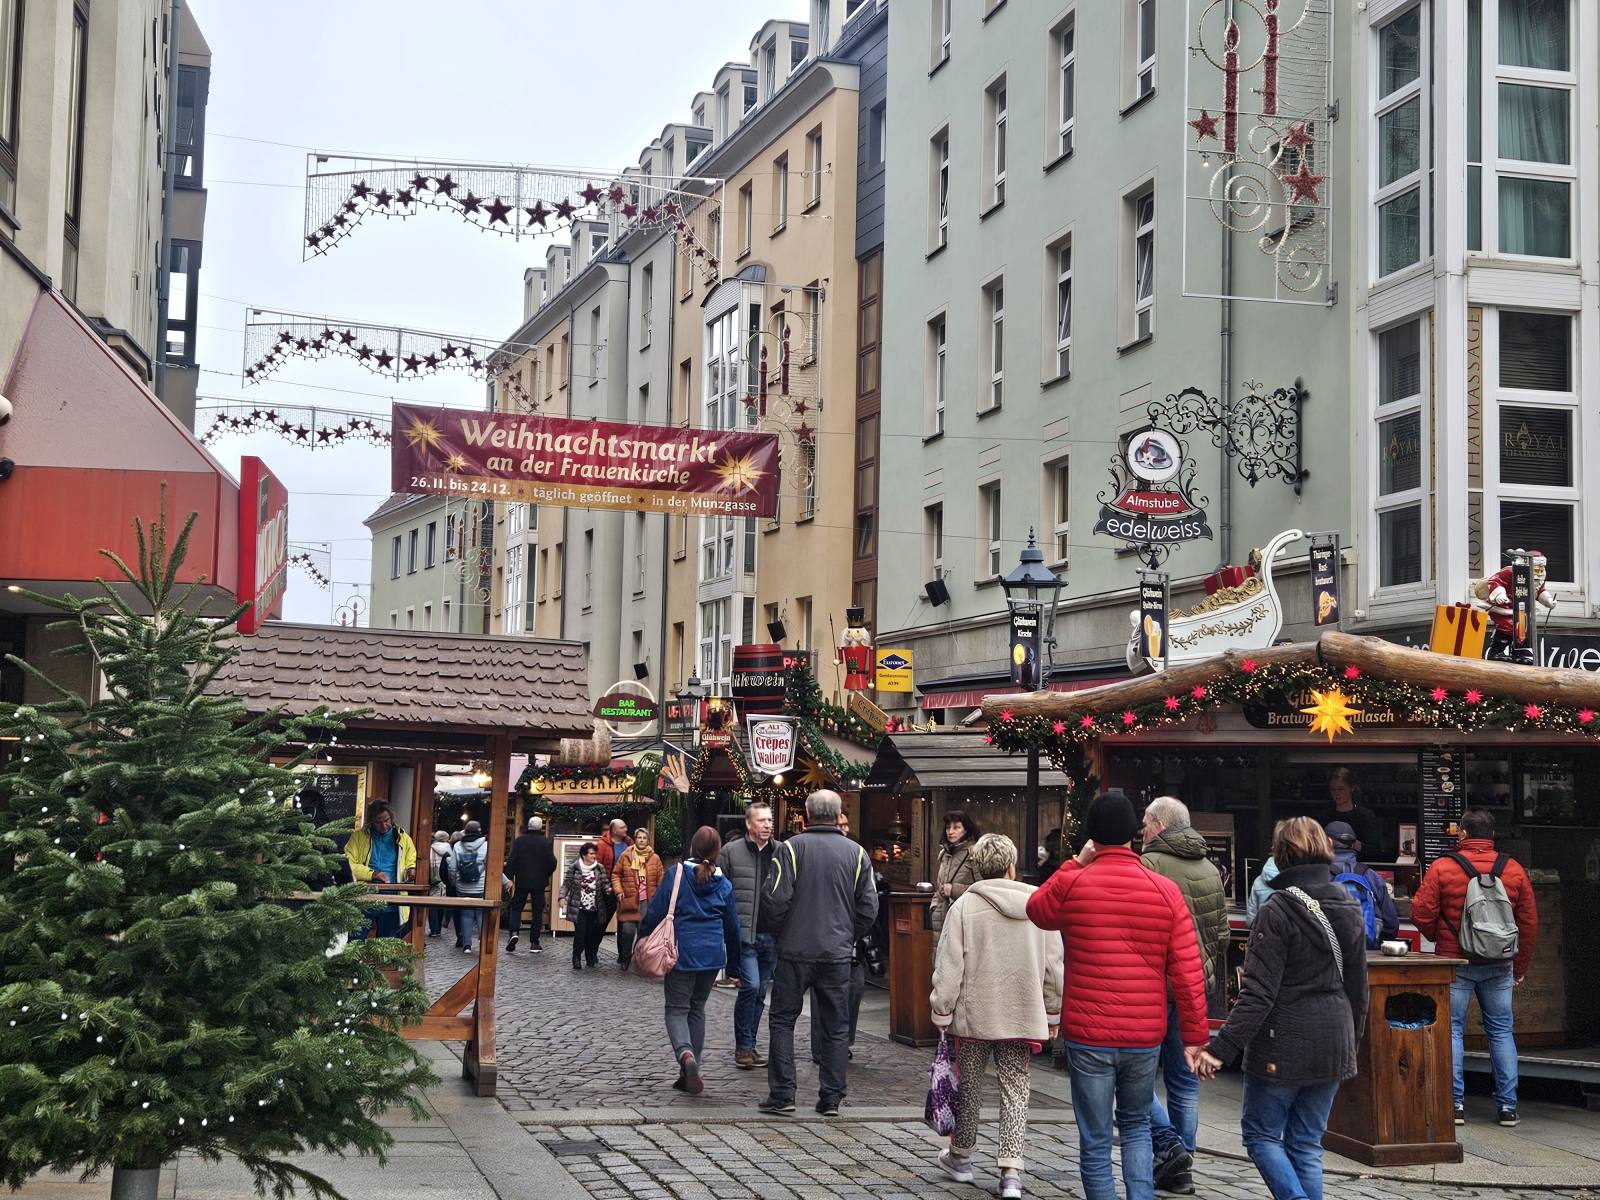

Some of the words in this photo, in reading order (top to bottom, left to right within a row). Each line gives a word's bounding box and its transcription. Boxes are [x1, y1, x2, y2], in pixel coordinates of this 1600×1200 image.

[460, 418, 717, 463] Weihnachtsmarkt
[486, 456, 513, 472] an
[520, 454, 554, 475] der
[560, 457, 690, 485] Frauenkirche
[450, 478, 468, 491] bis
[533, 487, 575, 501] täglich
[579, 491, 632, 503] geöffnet
[652, 494, 664, 506] in
[667, 495, 687, 507] der
[691, 497, 757, 511] Münzgasse
[1126, 495, 1180, 508] Almstube
[1106, 518, 1201, 539] edelweiss
[1468, 496, 1481, 571] ROYAL
[601, 707, 652, 717] RESTAURANT
[618, 699, 635, 708] BAR
[701, 733, 731, 742] Glühwein
[755, 736, 790, 751] Crêpes
